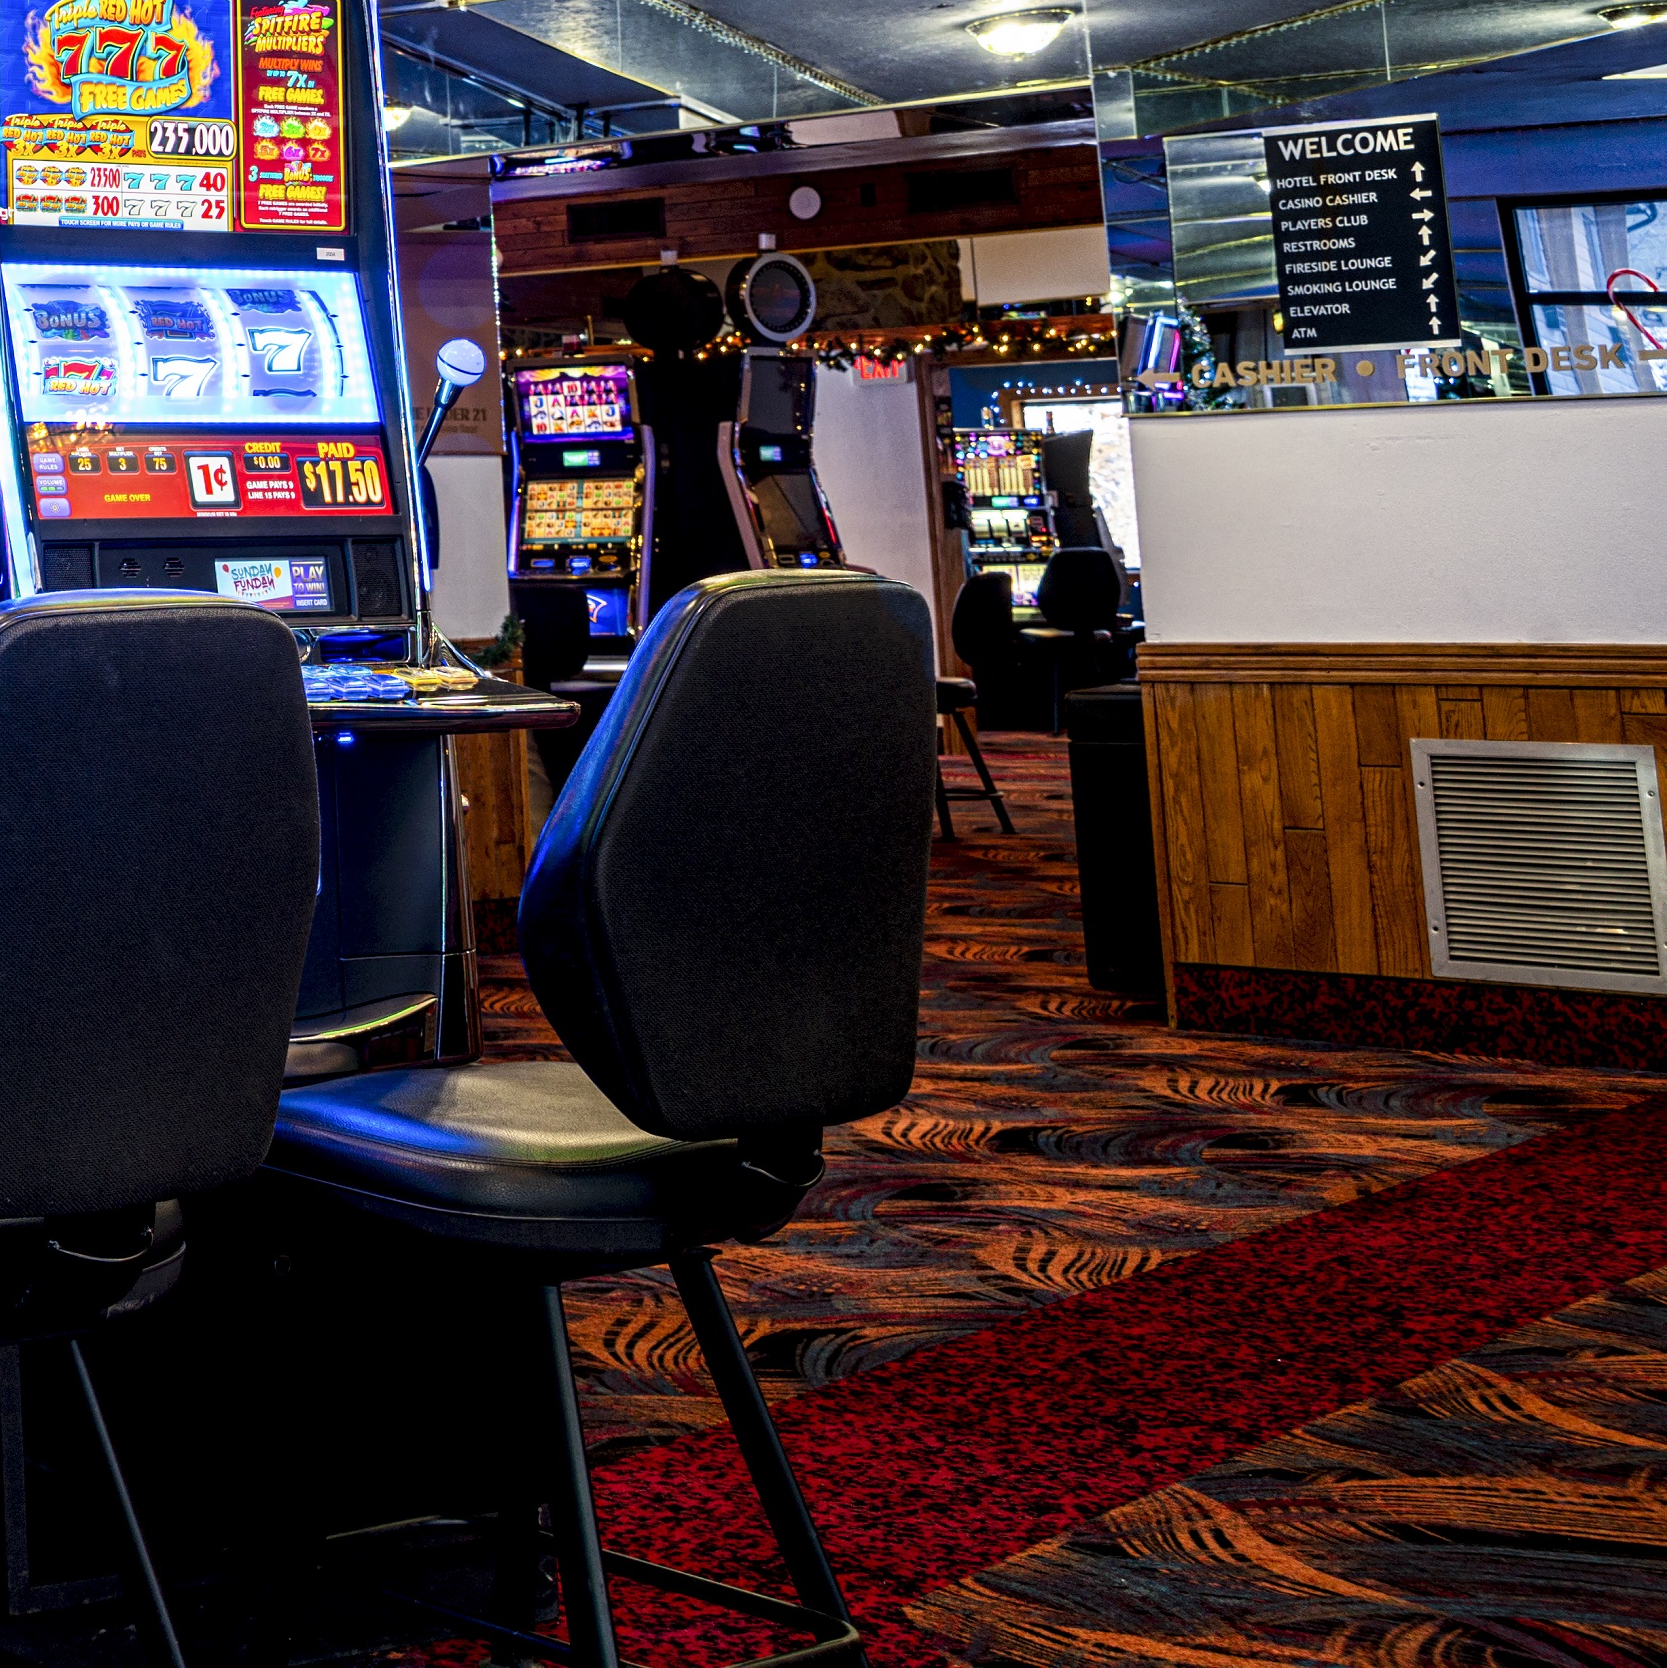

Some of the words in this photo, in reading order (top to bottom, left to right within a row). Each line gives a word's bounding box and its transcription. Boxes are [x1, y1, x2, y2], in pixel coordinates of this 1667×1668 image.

[253, 12, 322, 35] SPITFIRE
[255, 35, 324, 55] MULTIPLIERS
[79, 80, 128, 113] FREE
[131, 78, 188, 112] GAMES
[150, 120, 233, 156] 235,000
[1277, 127, 1415, 162] WELCOME
[199, 172, 226, 192] 40
[1276, 176, 1317, 190] HOTEL
[1319, 172, 1361, 186] FRONT
[1364, 168, 1397, 183] DESK
[201, 198, 225, 220] 25
[1278, 196, 1323, 211] CASINO
[1325, 192, 1378, 207] CASHIER
[1280, 217, 1333, 231] PLAYERS
[1335, 214, 1369, 228] CLUB
[1283, 238, 1356, 253] RESTROOMS
[1285, 260, 1338, 275] FIRESIDE
[1340, 256, 1393, 271] LOUNGE
[1287, 282, 1342, 296] SMOKING
[1344, 278, 1396, 293] LOUNGE
[1289, 304, 1351, 318] ELEVATOR
[1291, 328, 1318, 340] ATM
[1191, 357, 1337, 389] CASHIER
[1397, 347, 1514, 380] FRONT
[1525, 343, 1626, 374] DESK
[467, 408, 488, 422] 21
[244, 443, 282, 453] CREDIT
[317, 443, 355, 460] PAID
[304, 459, 383, 505] $17.50
[104, 493, 127, 503] GAME
[129, 493, 151, 503] OVER
[292, 566, 324, 580] PLAY
